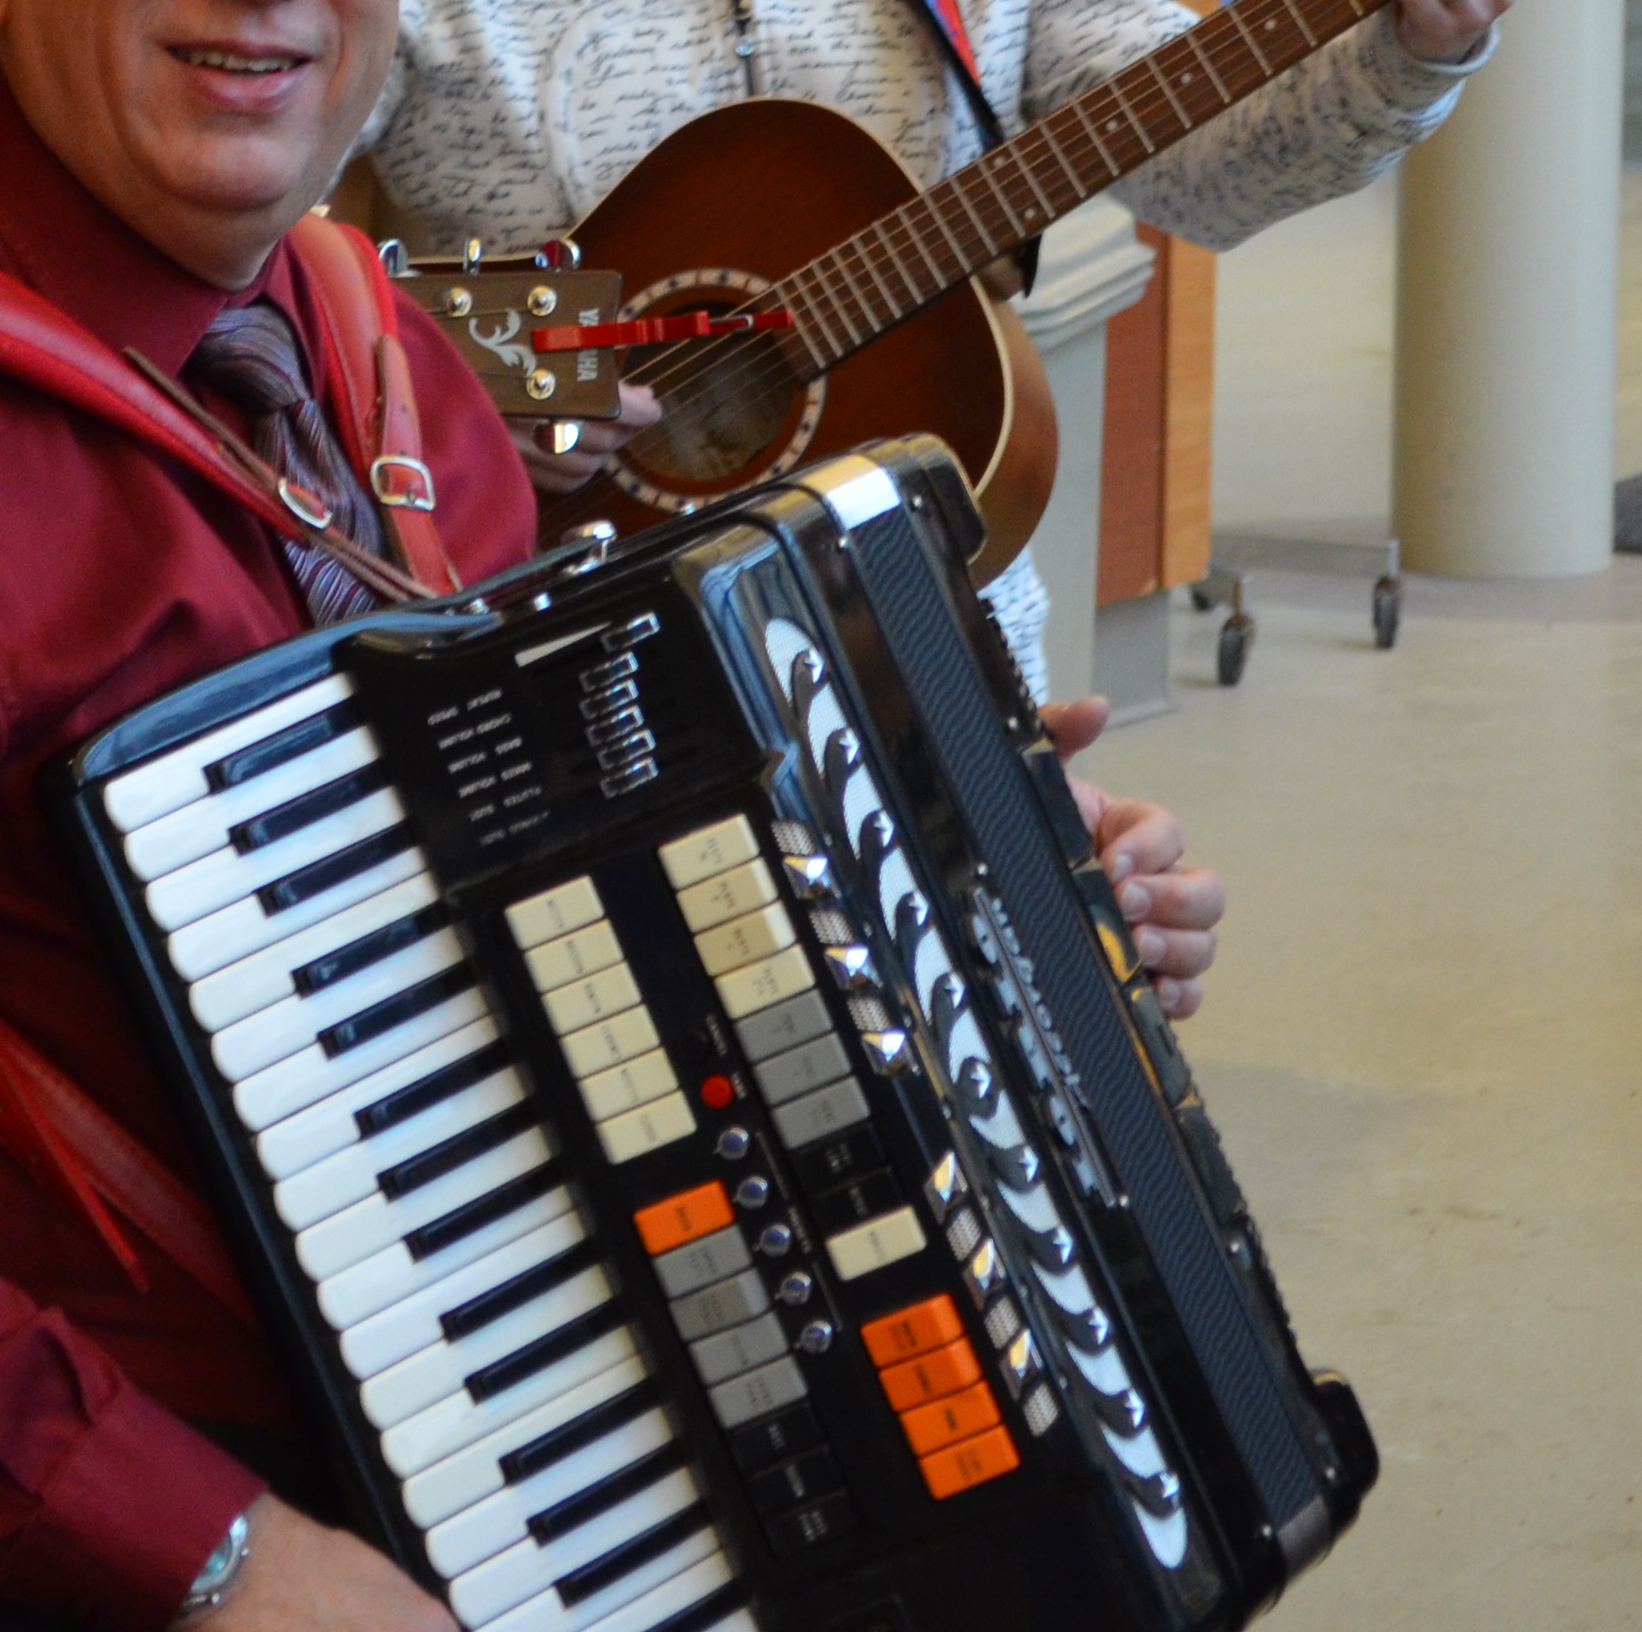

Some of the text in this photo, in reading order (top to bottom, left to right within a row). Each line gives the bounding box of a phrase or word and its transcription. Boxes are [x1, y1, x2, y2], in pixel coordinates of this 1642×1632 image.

[439, 729, 474, 749] VOLUME
[449, 752, 485, 773] VOLUME
[459, 777, 495, 797] VOLUME
